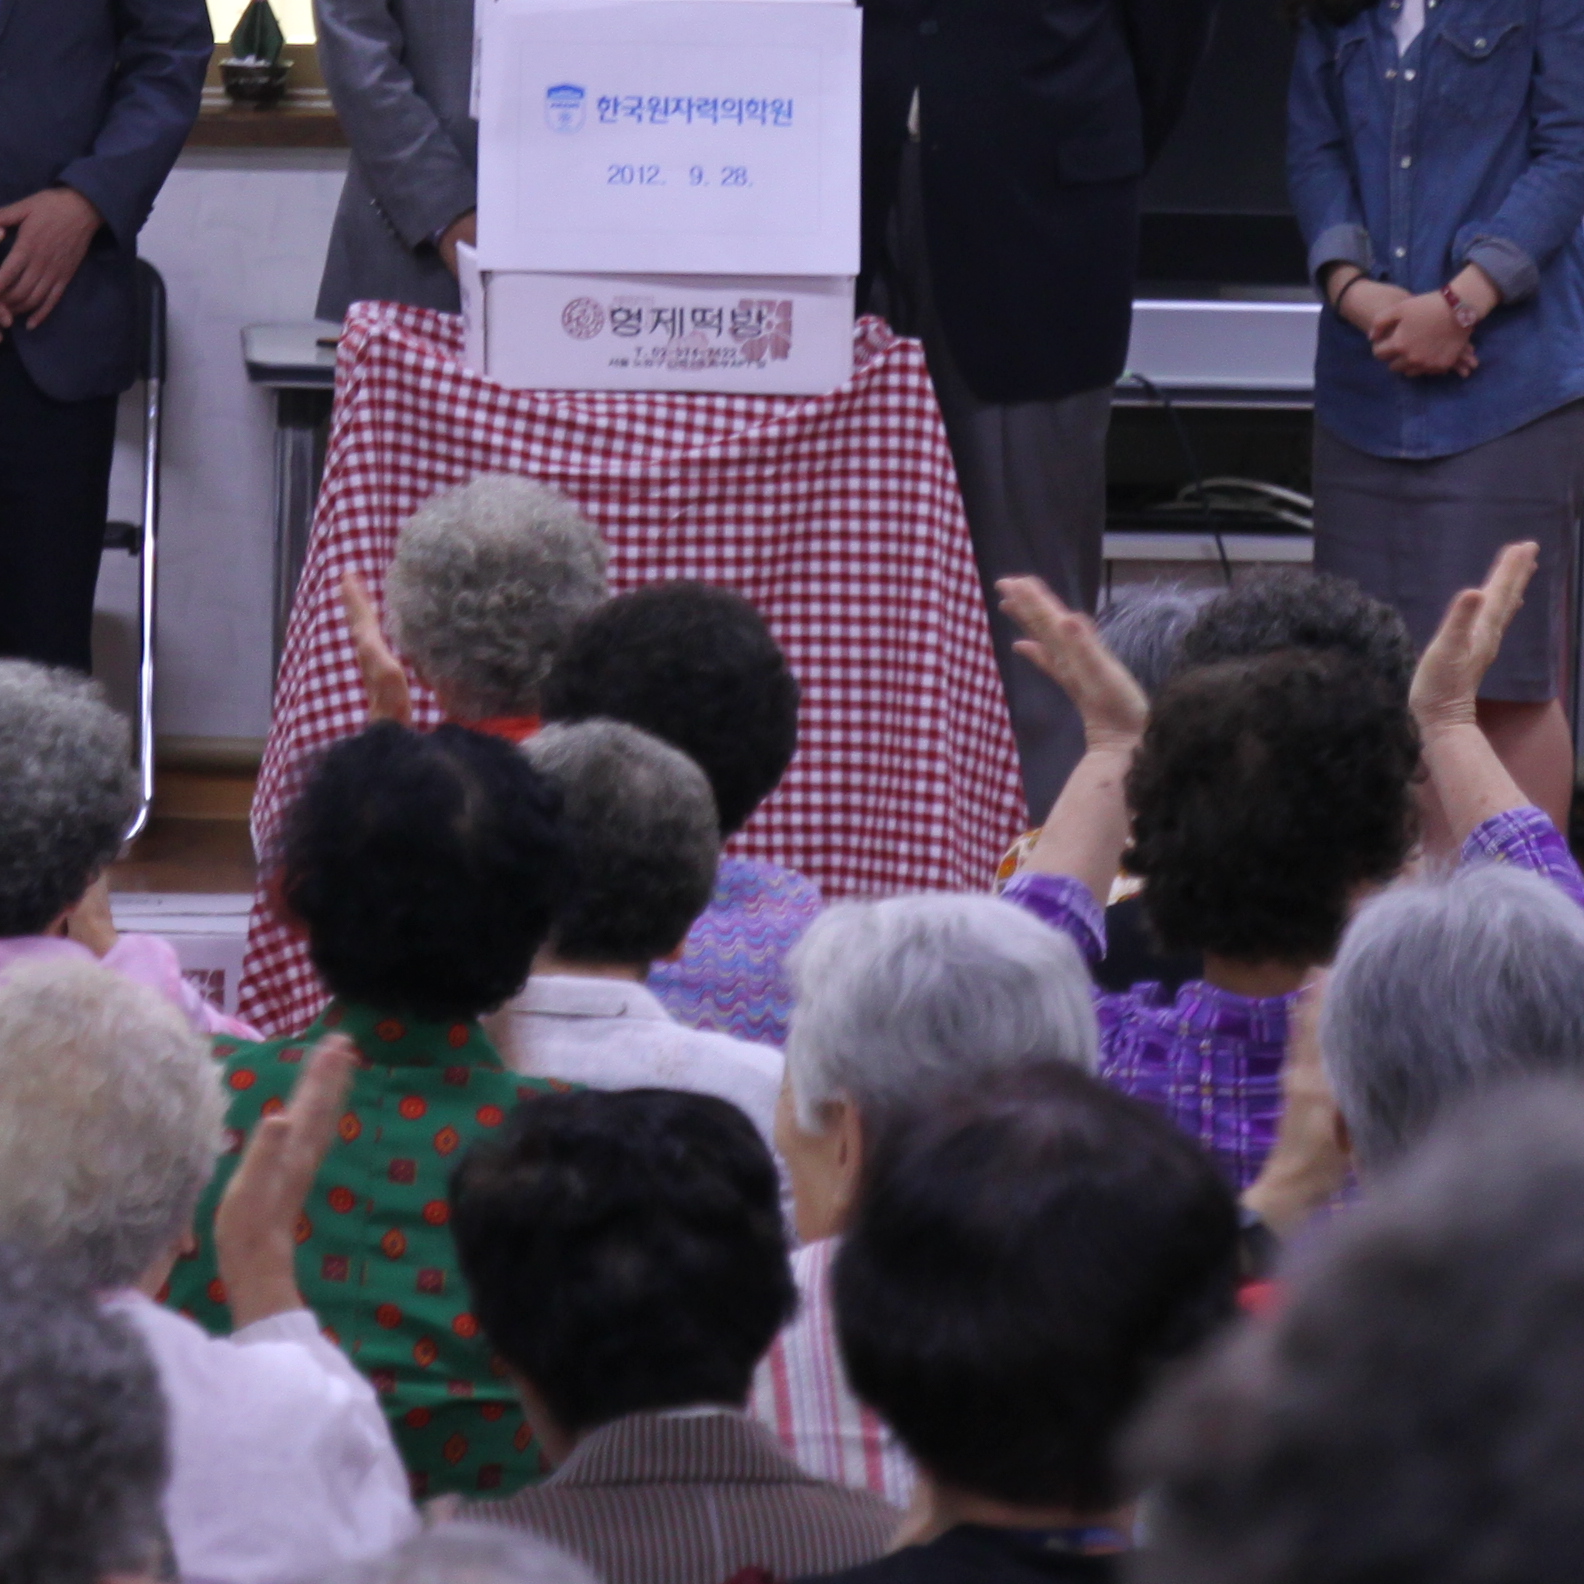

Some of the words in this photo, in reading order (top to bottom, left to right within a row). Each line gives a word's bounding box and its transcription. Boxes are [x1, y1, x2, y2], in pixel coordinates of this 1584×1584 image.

[596, 95, 794, 128] 한국원자력의학원
[606, 164, 666, 186] 2012.
[688, 164, 710, 187] 9.
